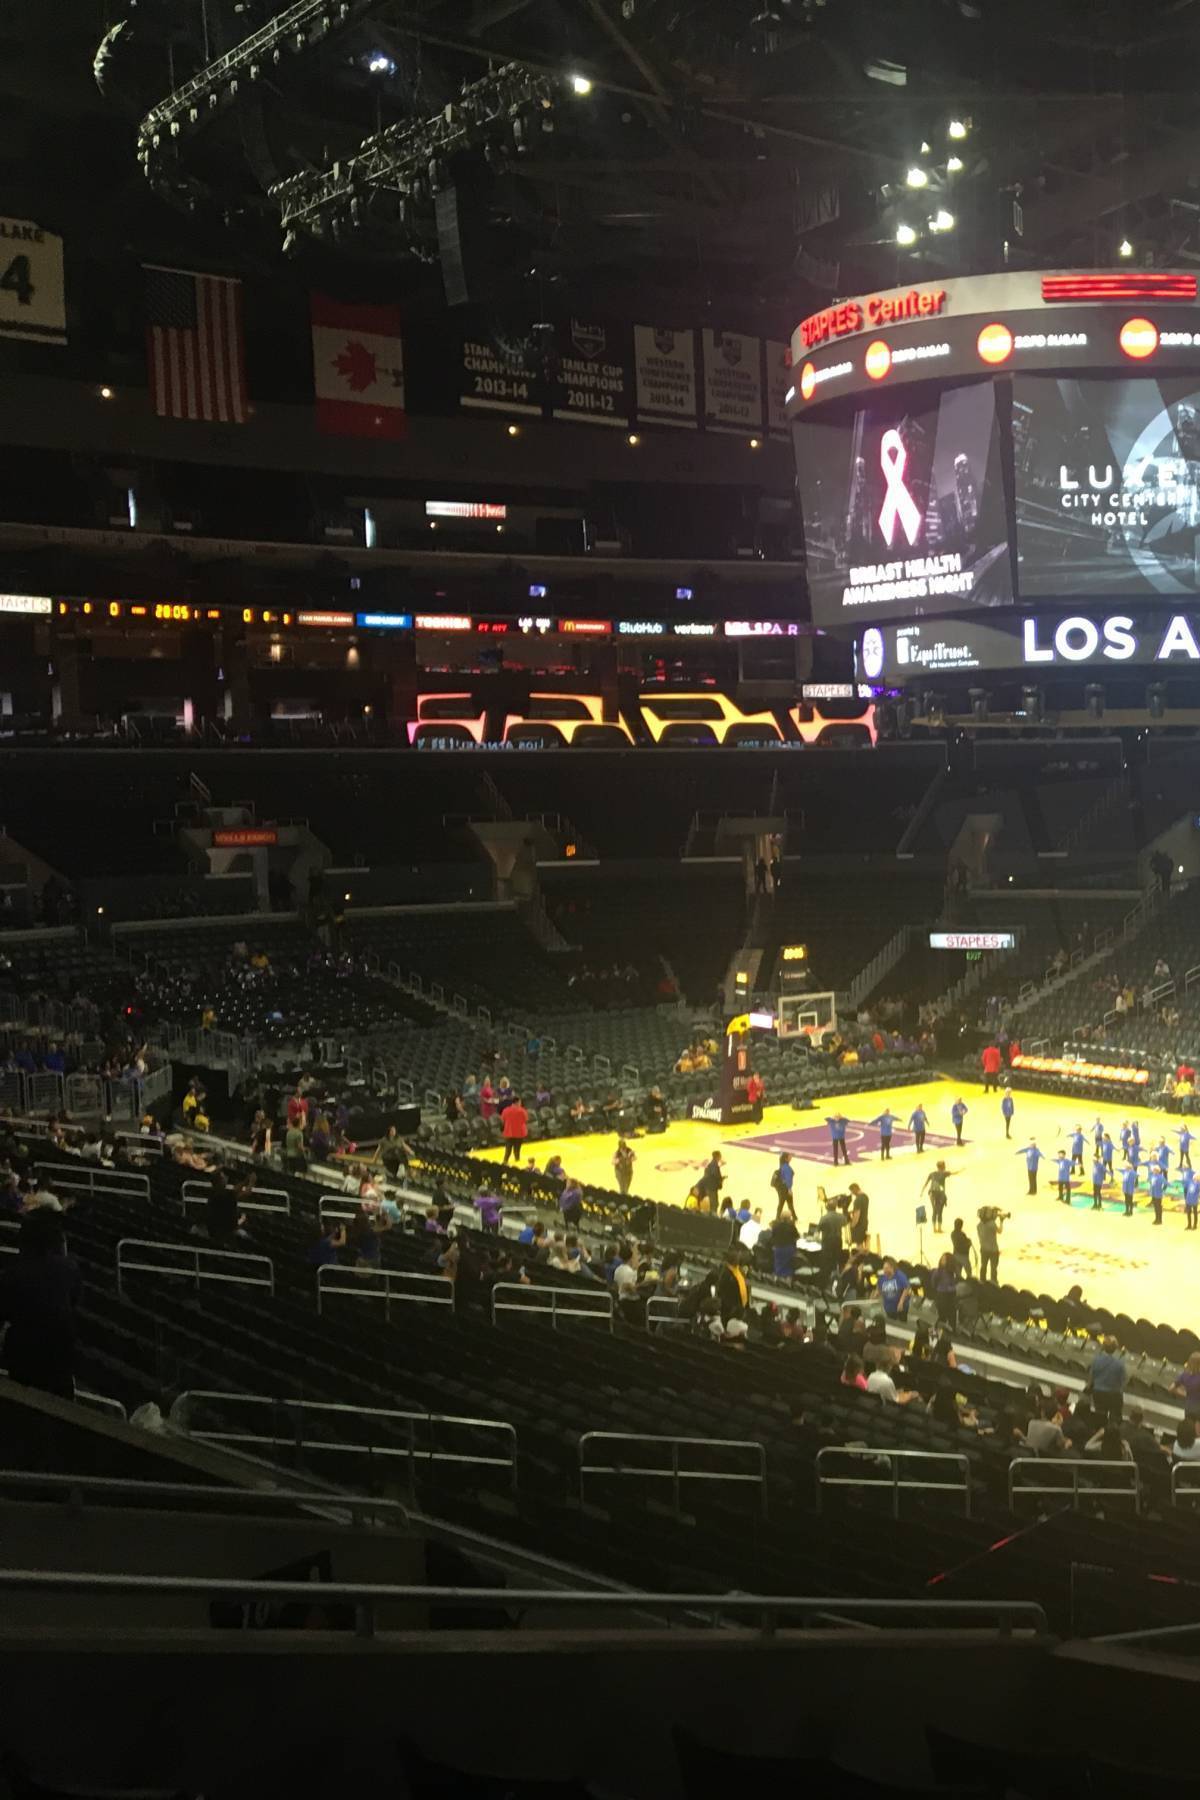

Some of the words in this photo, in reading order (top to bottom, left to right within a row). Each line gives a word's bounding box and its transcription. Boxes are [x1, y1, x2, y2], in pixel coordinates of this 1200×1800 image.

[800, 303, 860, 346] STAPLES
[865, 290, 945, 324] Center
[561, 357, 598, 374] TANLEY
[602, 362, 624, 377] CUP
[474, 377, 529, 399] 2013-14
[567, 390, 616, 411] 2011-12
[1061, 494, 1101, 508] CITY
[1091, 512, 1149, 526] HOTEL
[906, 553, 962, 578] HEALTH
[619, 622, 663, 634] StubHub
[1024, 616, 1137, 662] LOS
[946, 935, 999, 948] STAPLES
